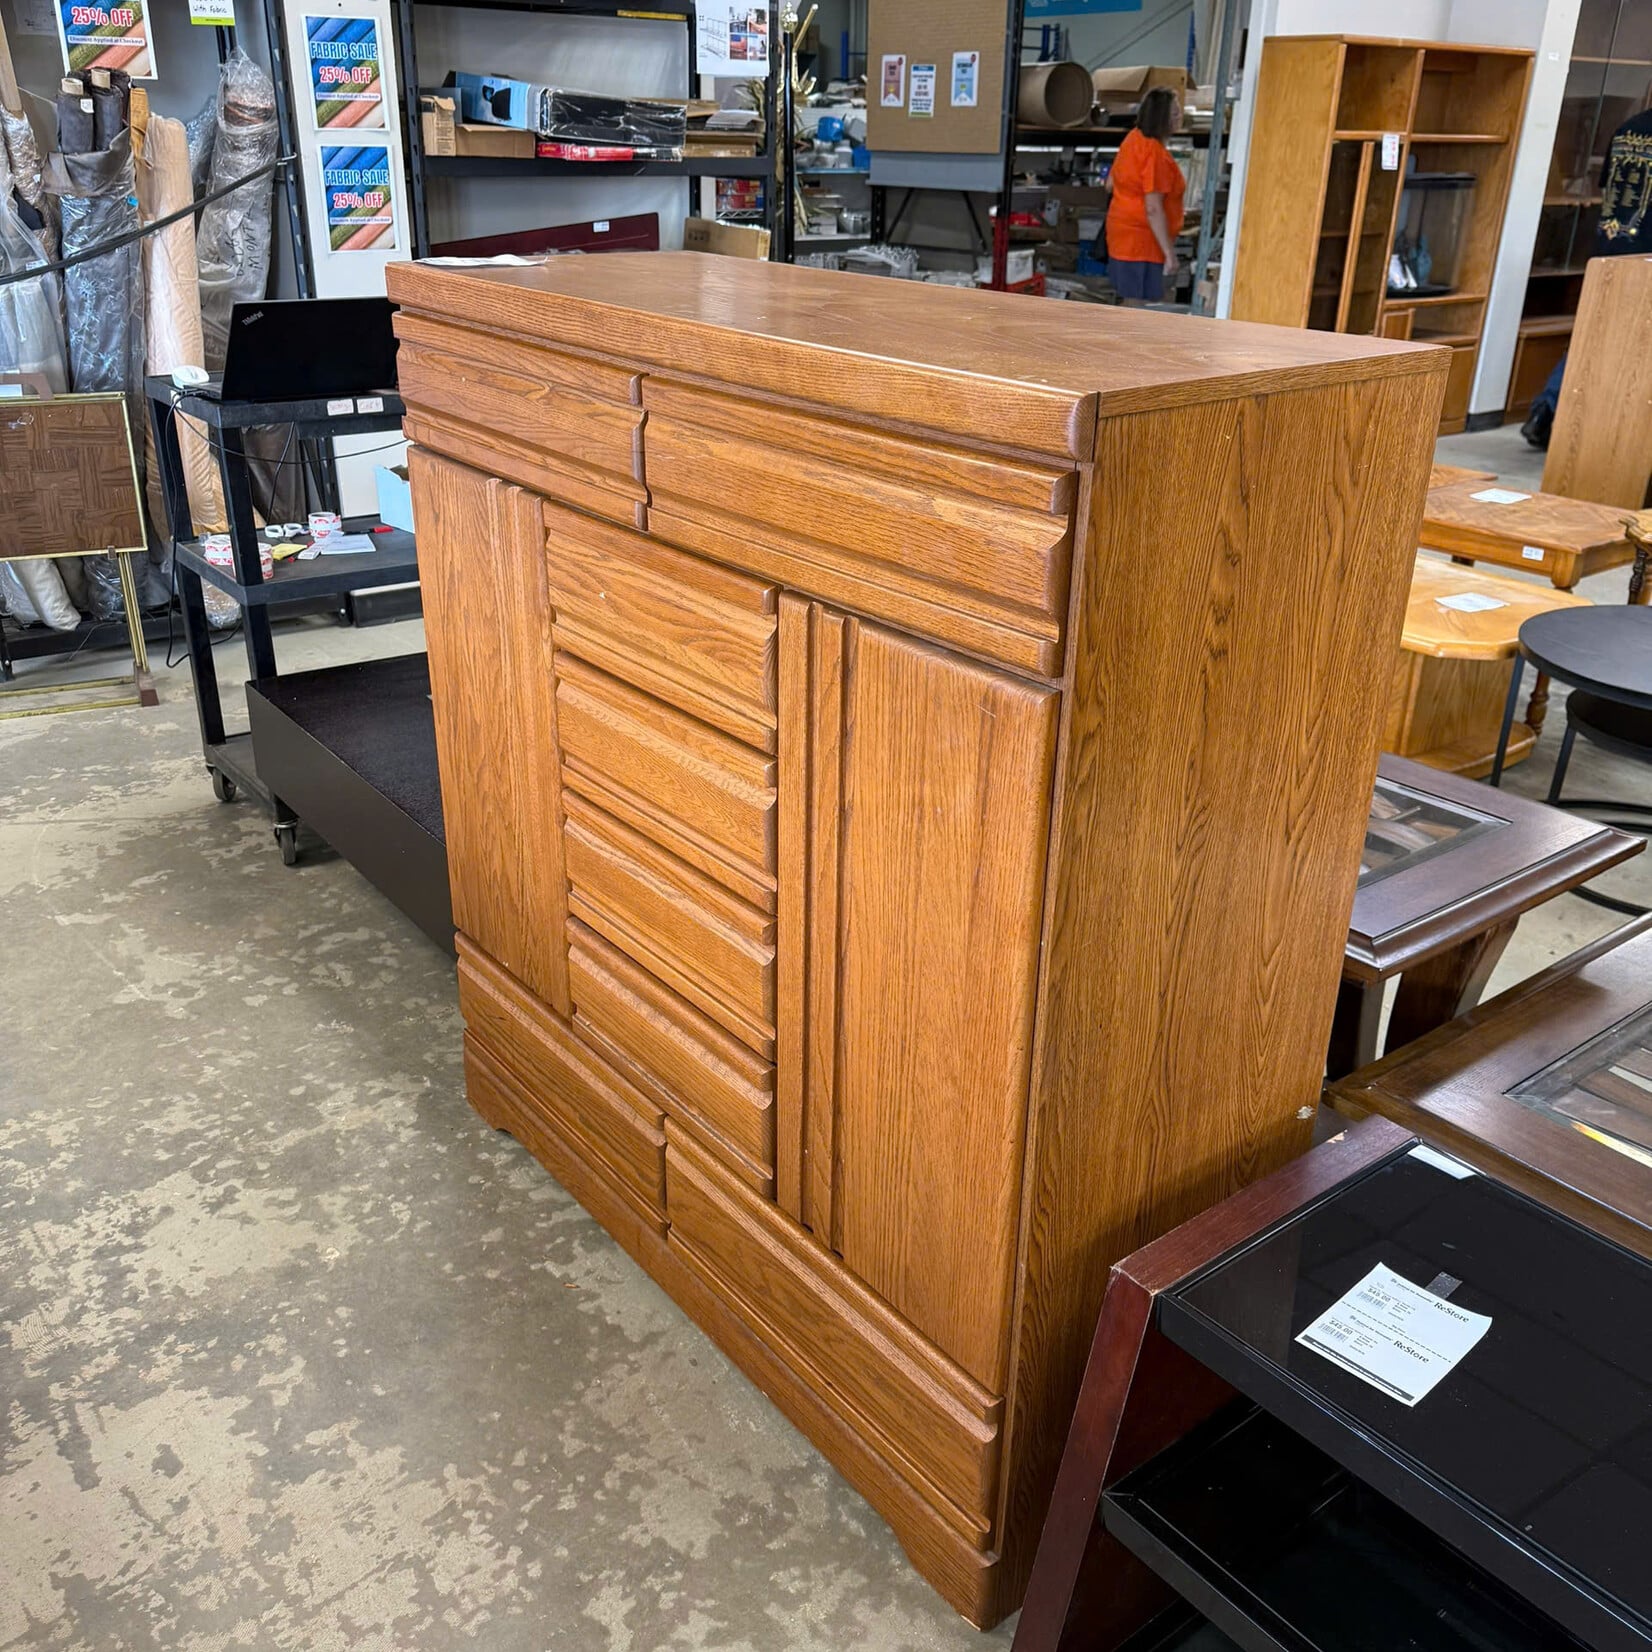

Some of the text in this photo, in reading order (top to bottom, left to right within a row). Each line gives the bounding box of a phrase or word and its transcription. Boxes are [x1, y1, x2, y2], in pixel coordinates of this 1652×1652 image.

[72, 6, 132, 27] 25% OFF
[310, 41, 377, 60] FABRIC SALE
[319, 66, 372, 84] 25% OFF
[325, 169, 390, 186] FABRIC SALE
[333, 192, 384, 208] 25% OFF
[1434, 1302, 1470, 1323] ReStore
[1393, 1340, 1430, 1363] ReStore
